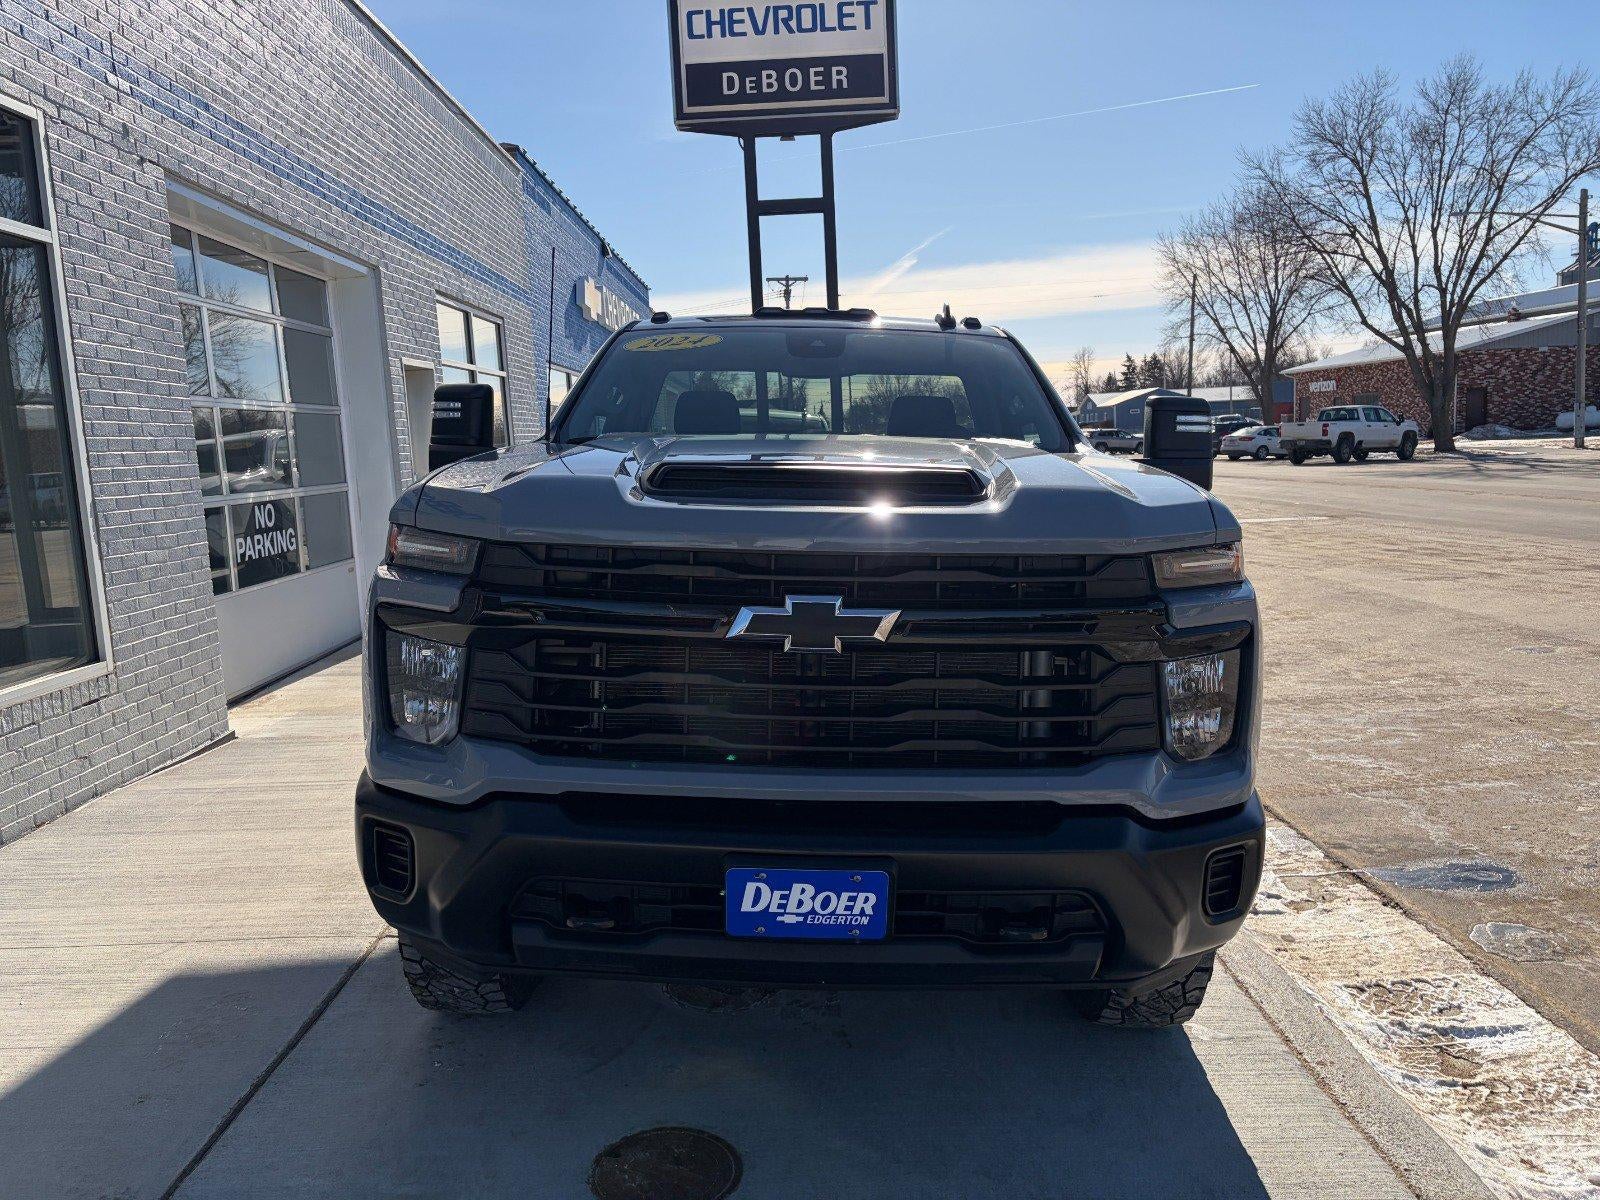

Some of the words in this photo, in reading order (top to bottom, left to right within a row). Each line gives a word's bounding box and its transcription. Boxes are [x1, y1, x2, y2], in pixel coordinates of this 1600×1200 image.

[686, 0, 878, 39] CHEVROLET
[1309, 379, 1336, 392] verizon
[254, 503, 275, 529] NO
[236, 528, 296, 562] PARKING
[807, 914, 869, 925] EDGERTON
